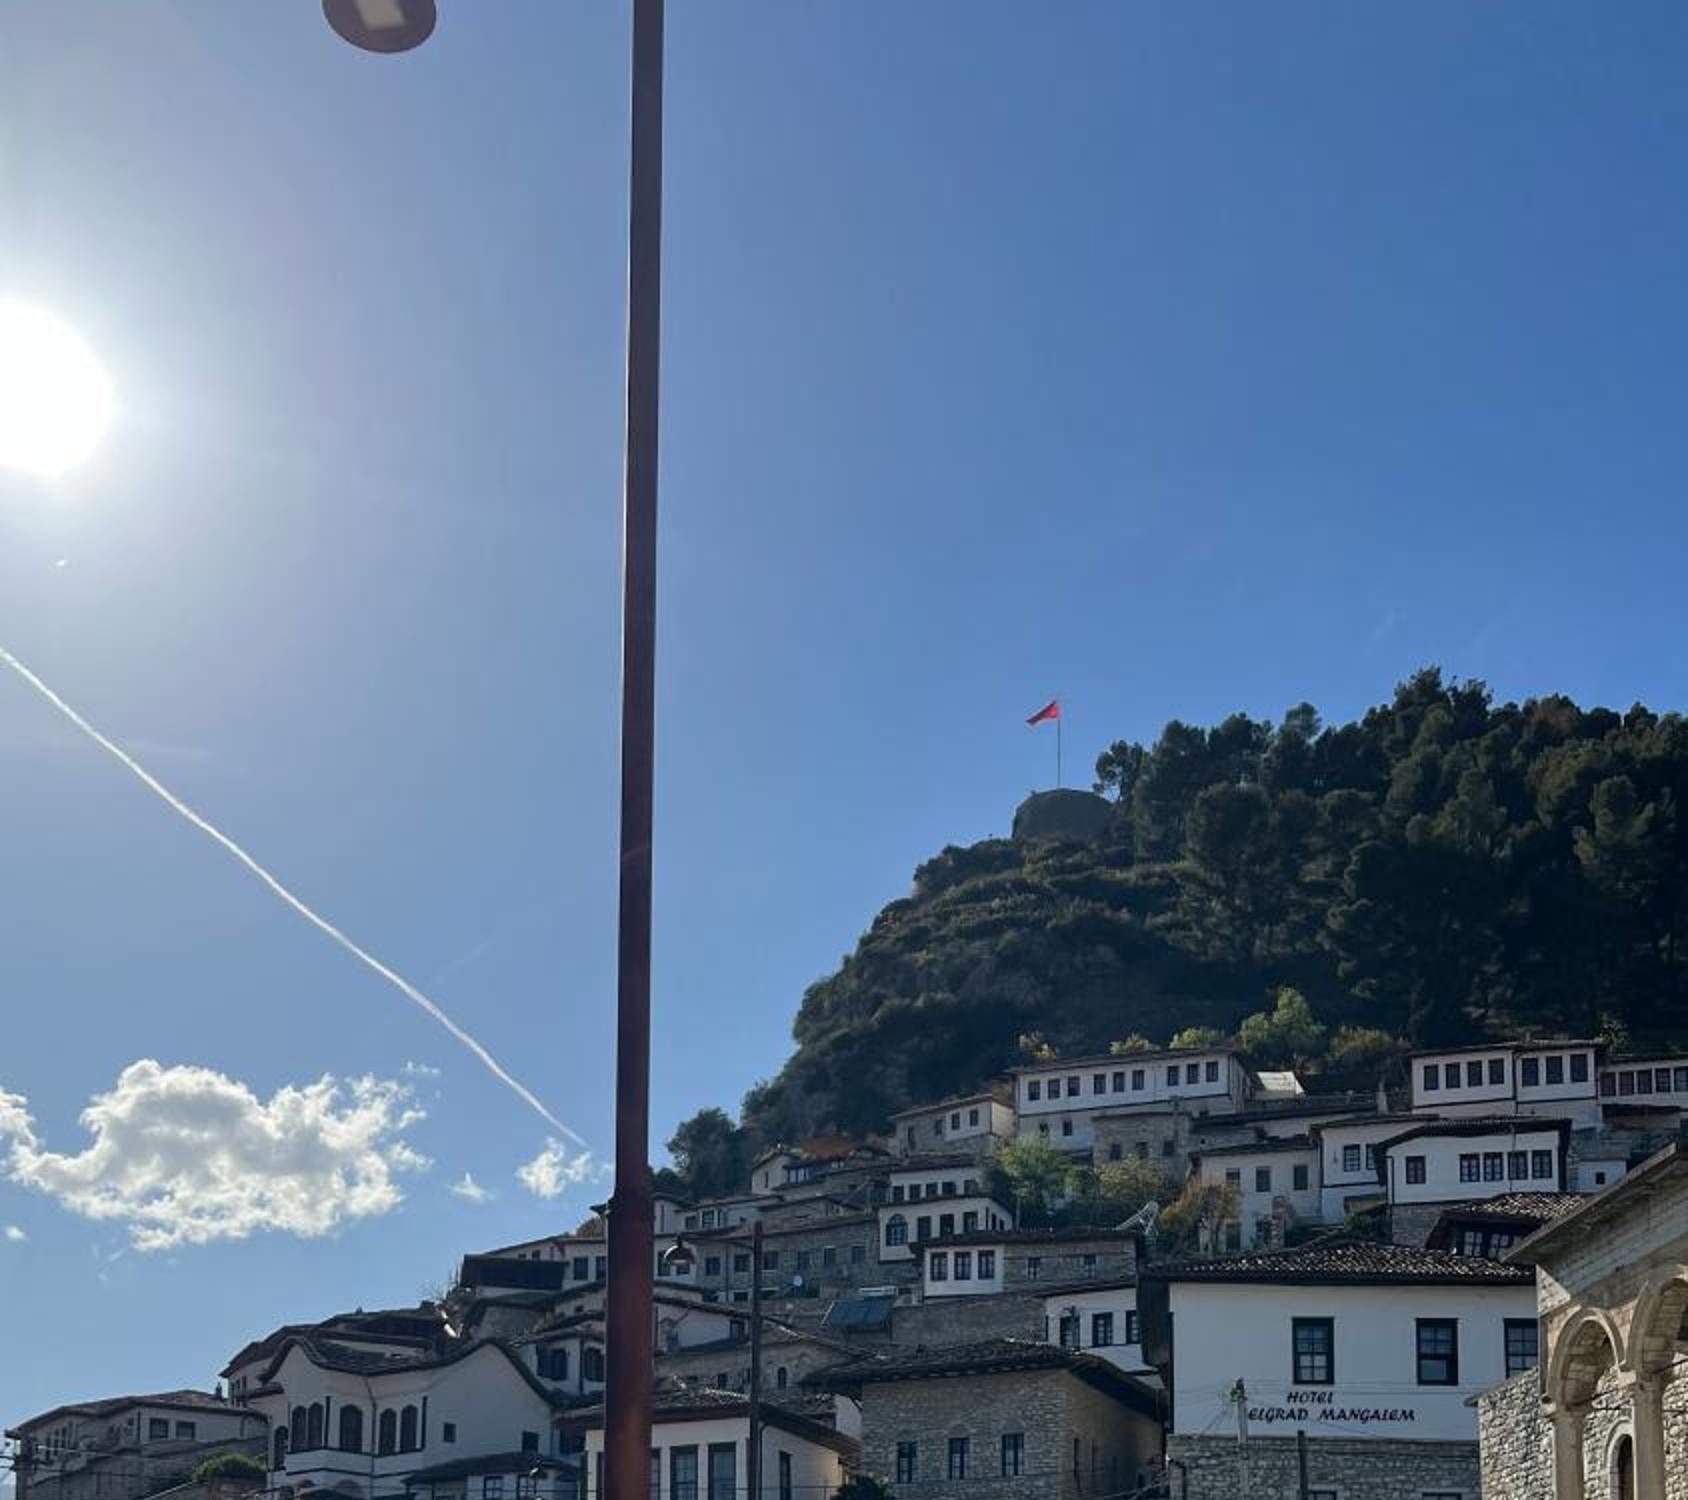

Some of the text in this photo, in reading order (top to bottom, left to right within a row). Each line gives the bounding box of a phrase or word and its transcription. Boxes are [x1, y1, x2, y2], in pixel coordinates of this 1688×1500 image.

[1287, 1391, 1333, 1404] HOTEL
[1246, 1408, 1415, 1423] ELGRAD MANGALEM
